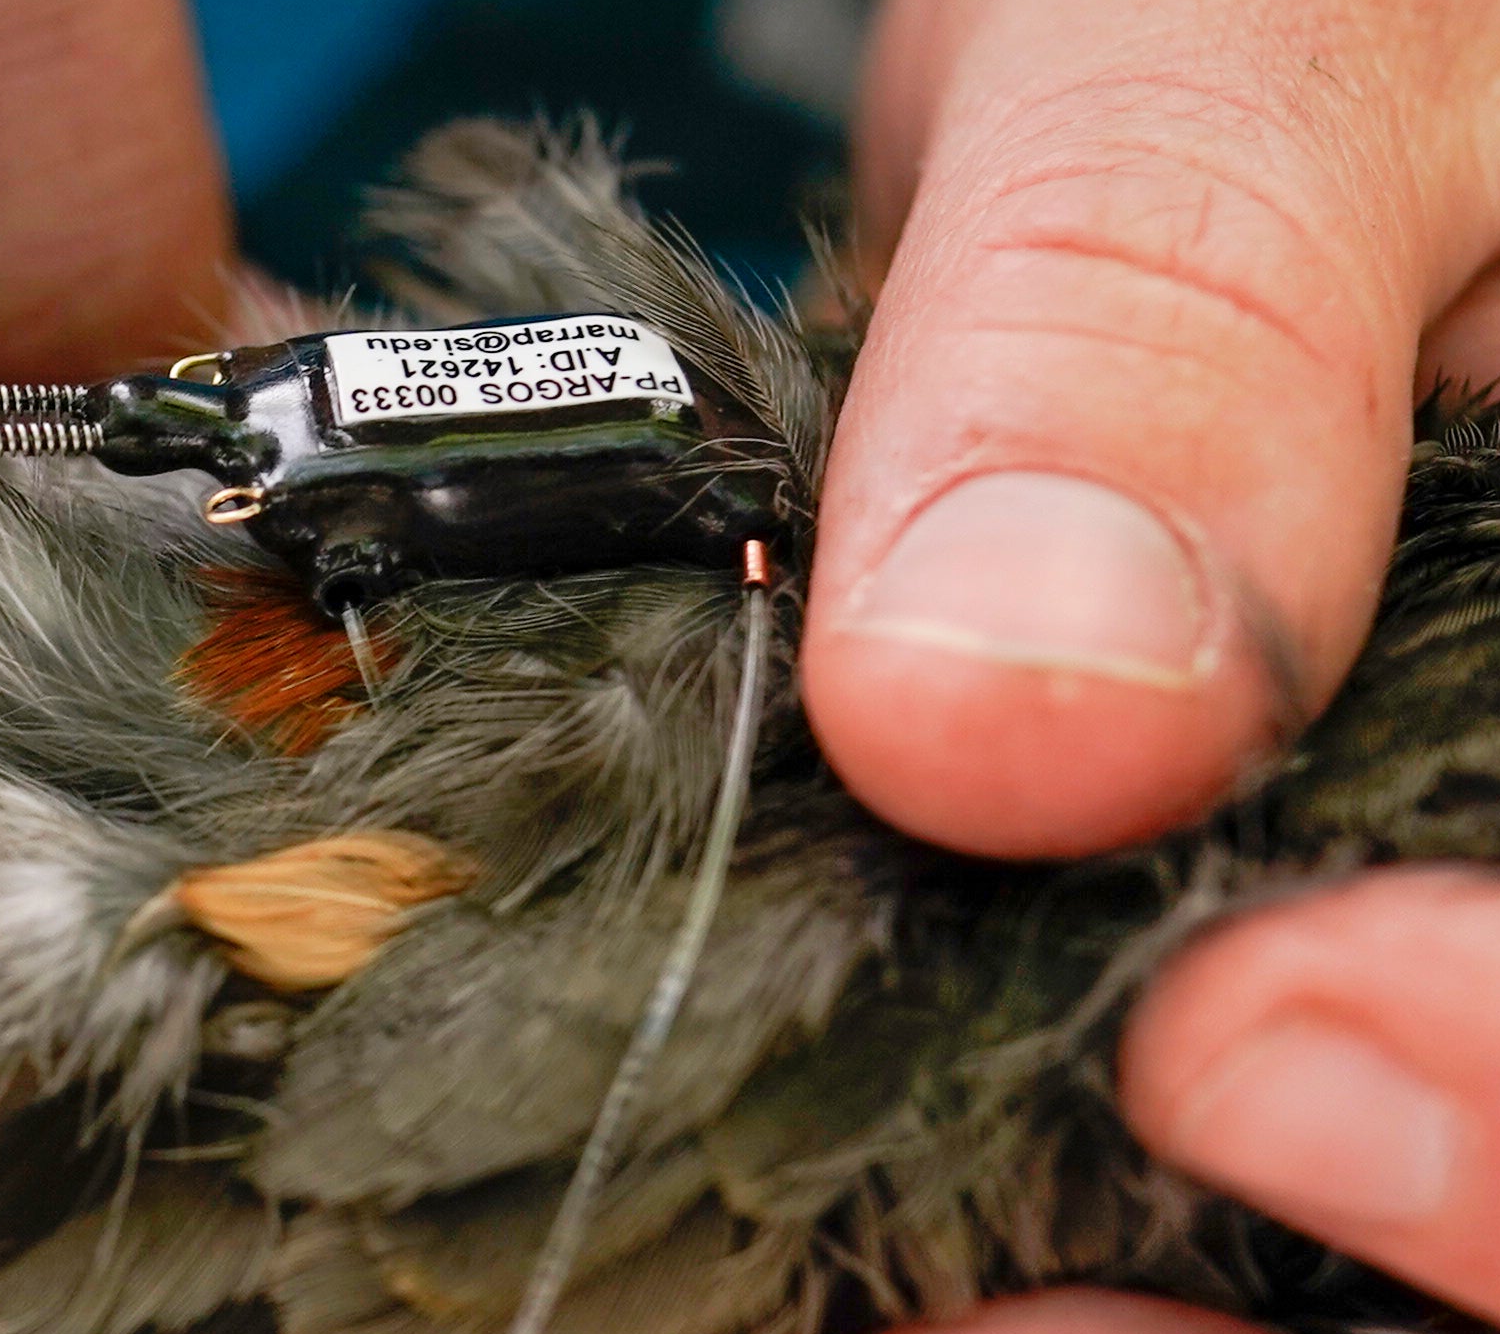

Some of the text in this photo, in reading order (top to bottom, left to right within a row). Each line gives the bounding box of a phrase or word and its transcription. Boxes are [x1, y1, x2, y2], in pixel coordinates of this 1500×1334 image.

[367, 324, 640, 355] marrap@si.edu
[401, 347, 622, 379] A.ID: 142621
[351, 371, 683, 414] PP-ARGOS 00333
